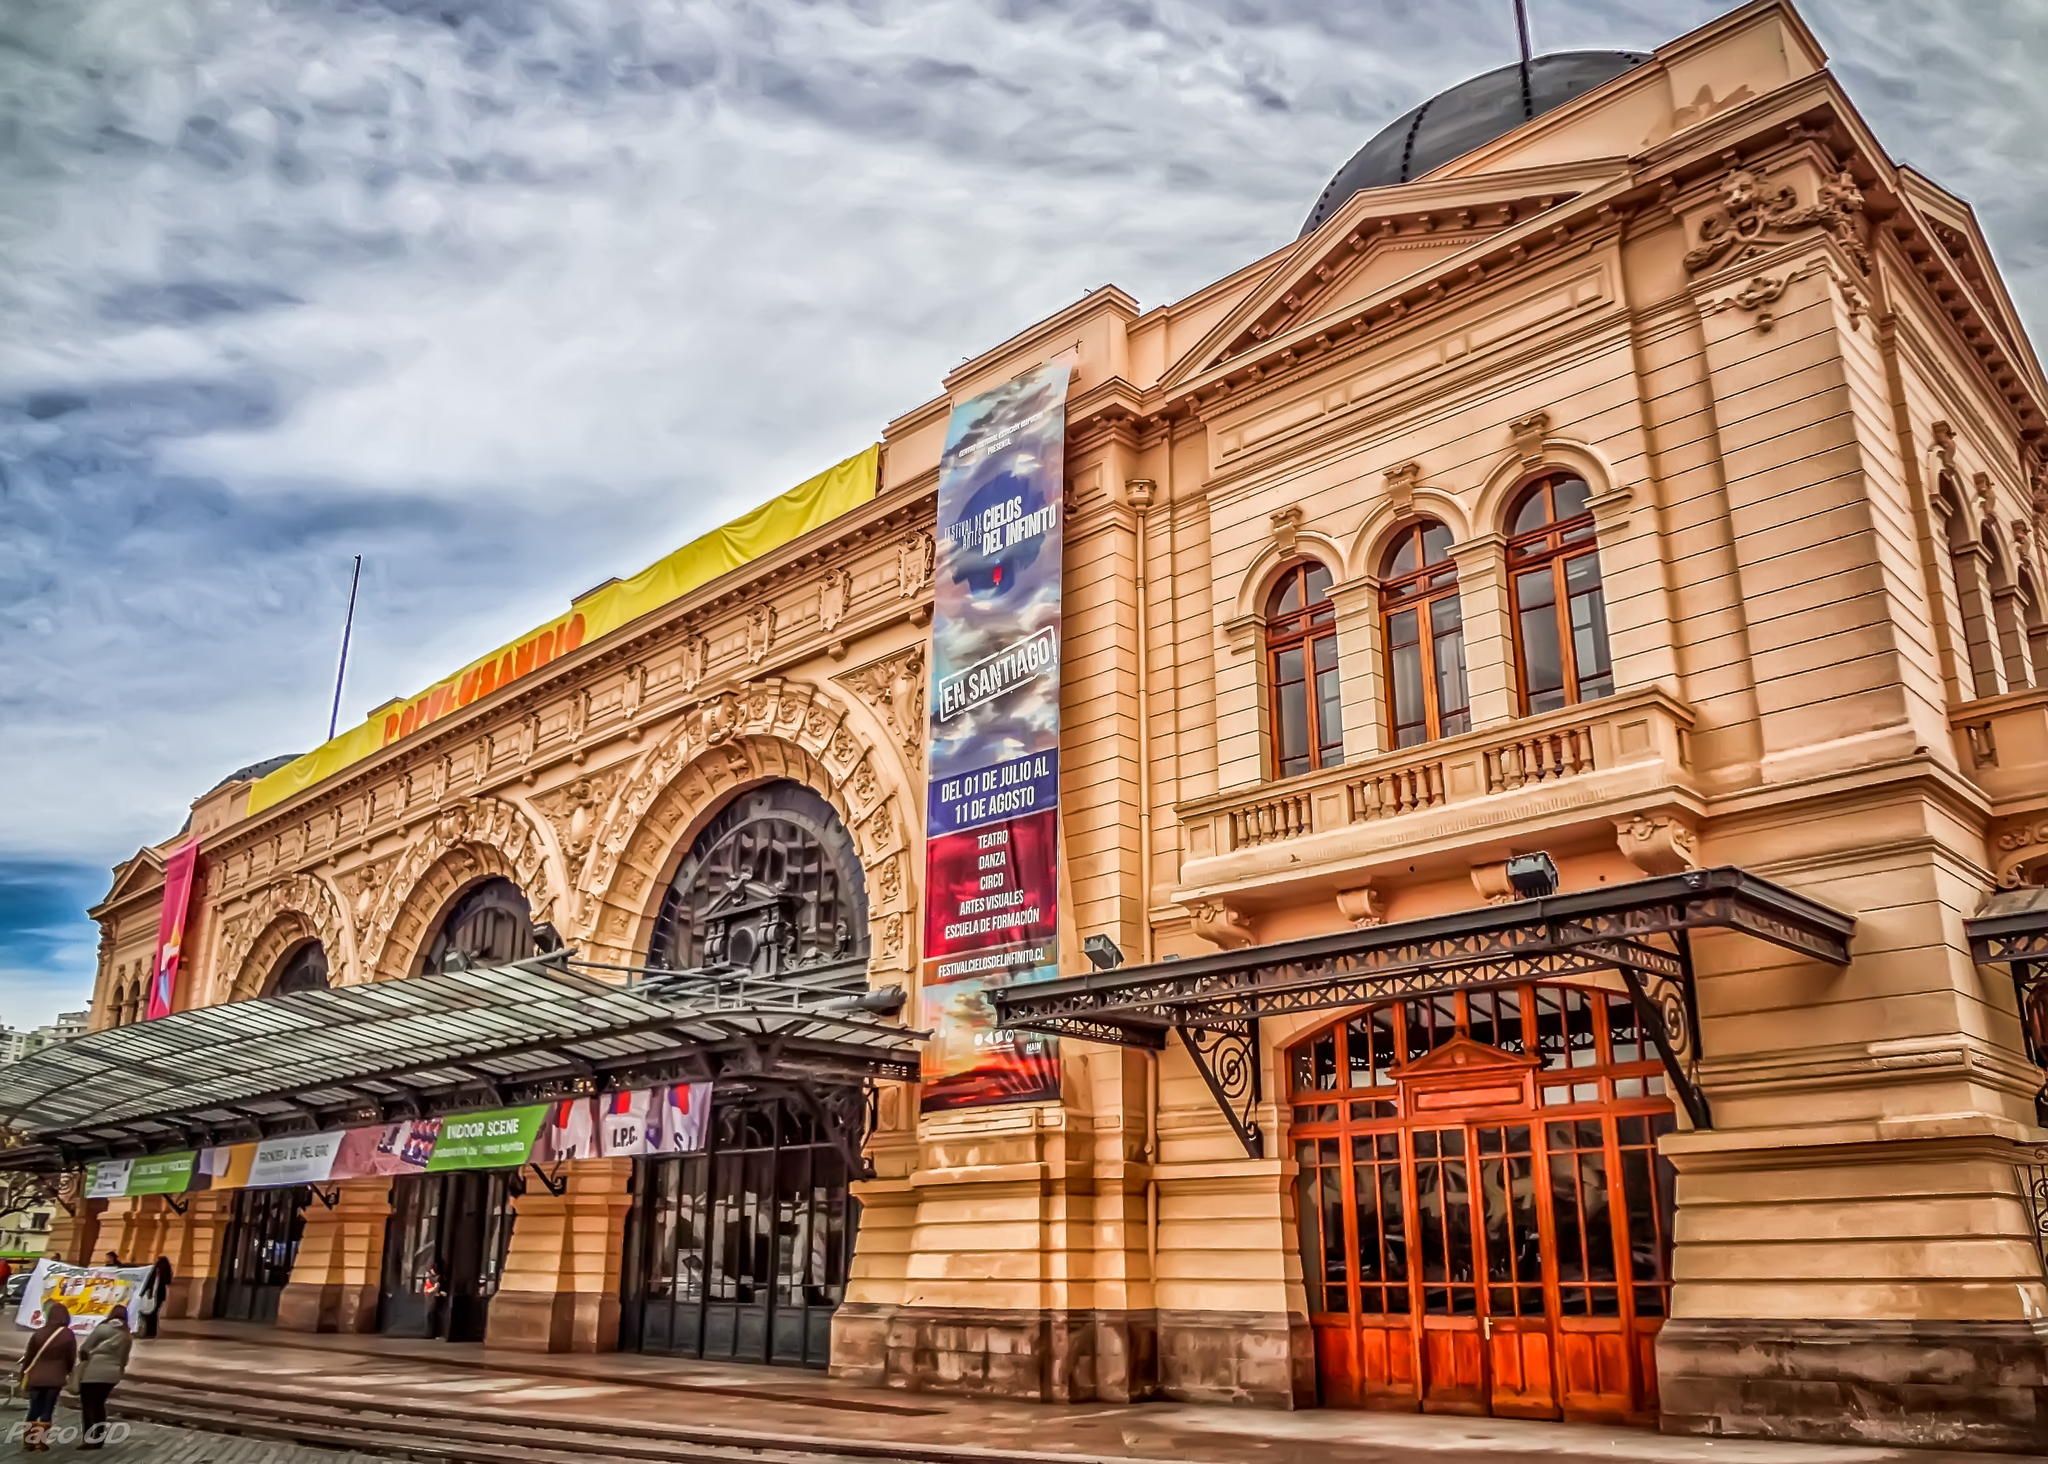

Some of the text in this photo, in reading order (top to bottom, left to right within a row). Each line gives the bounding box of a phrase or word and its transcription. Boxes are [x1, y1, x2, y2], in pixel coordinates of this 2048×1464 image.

[983, 495, 1022, 532] CIELOS
[983, 503, 1056, 557] DEL INFINITO
[943, 636, 1050, 714] EN SANTIAGO
[941, 756, 1049, 803] DEL 01 DE JULIO AL
[955, 786, 1034, 824] 11 DE AGOSTO
[978, 830, 1008, 849] TEATRO
[978, 851, 1006, 870] DANZA
[980, 872, 1004, 891] CIRCO
[959, 889, 1024, 916] ARTES VISUALES
[945, 907, 1040, 940] ESCUELA DE FORMACIÓN
[938, 947, 1045, 978] FESTIVALCIELOSDELINFINITO.CL
[447, 1118, 520, 1139] INDOOR SCENE
